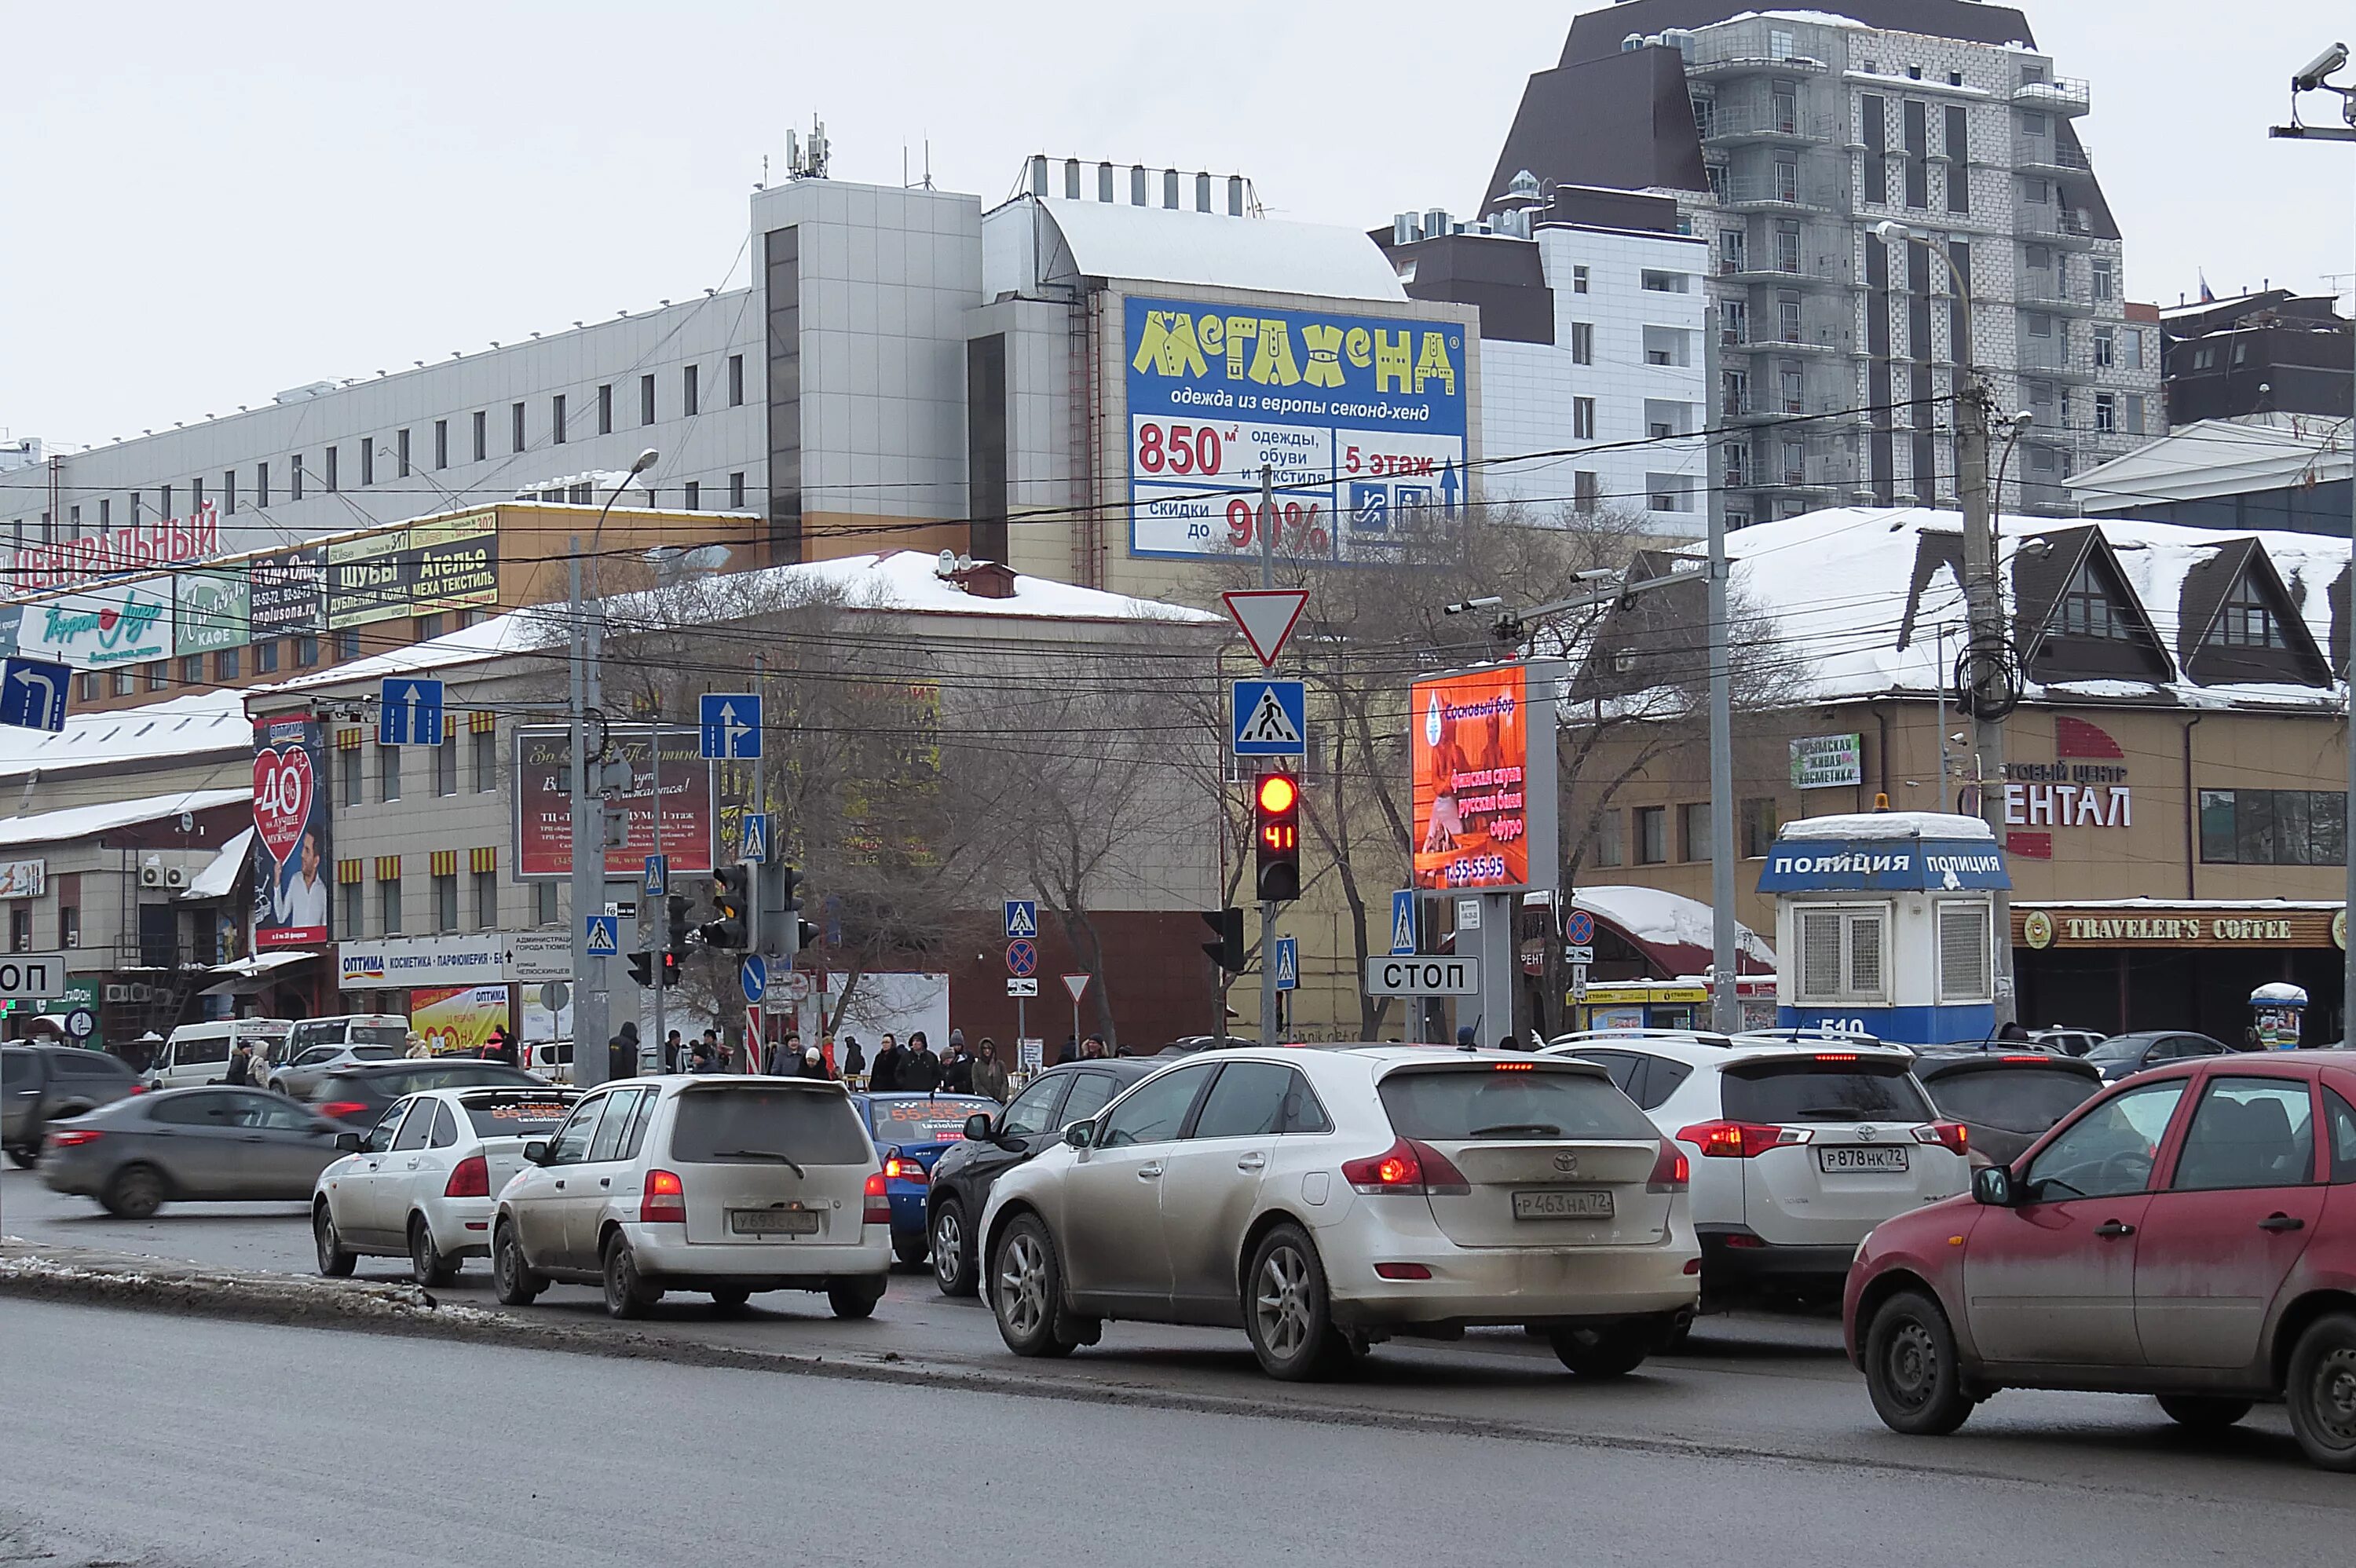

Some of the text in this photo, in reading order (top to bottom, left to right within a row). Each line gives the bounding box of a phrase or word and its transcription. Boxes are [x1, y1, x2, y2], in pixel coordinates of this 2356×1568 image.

[1171, 389, 1429, 422] одежда из европы секонд-хенд
[1139, 422, 1223, 477] 850
[1251, 430, 1319, 449] одежды,
[1259, 448, 1307, 467] обуви
[1345, 446, 1434, 477] 5 этаж
[1242, 469, 1326, 485] и ткстиля
[1150, 502, 1210, 519] скидки
[477, 515, 494, 533] 302
[1187, 524, 1210, 539] до
[13, 497, 220, 592] ЦЕНТРАЛЬНЫЙ
[391, 532, 408, 550] 317
[419, 548, 488, 579] Ателье
[412, 570, 495, 598] МЕХА ТЕКСТИЛЬ
[330, 585, 408, 614] ДУБЛЕНКИ КОЖА
[198, 628, 231, 647] КАФЕ
[1444, 695, 1515, 721] Сосновый бор
[269, 721, 304, 739] ОПТИМА
[1451, 768, 1492, 795] финская
[1798, 769, 1853, 785] КОСМЕТИКА
[2072, 764, 2127, 784] ЦЕНТР
[1458, 789, 1523, 820] русская баня
[1265, 826, 1293, 849] 41
[1489, 815, 1524, 842] офуро
[1774, 855, 1911, 875] ПОЛИЦИЯ
[1926, 855, 2001, 875] ПОЛИЦИЯ
[2211, 918, 2292, 940] COFFEE
[343, 955, 385, 972] ОПТИМА
[390, 956, 432, 970] КОСМЕТИКА
[437, 952, 488, 967] ПАРФЮМЕРИЯ
[1383, 963, 1465, 989] СТОП
[476, 989, 507, 1003] ОПТИМА
[1820, 1018, 1864, 1040] 510
[1827, 1149, 1902, 1167] Р878НК 72
[1522, 1193, 1607, 1214] Р463НА 72
